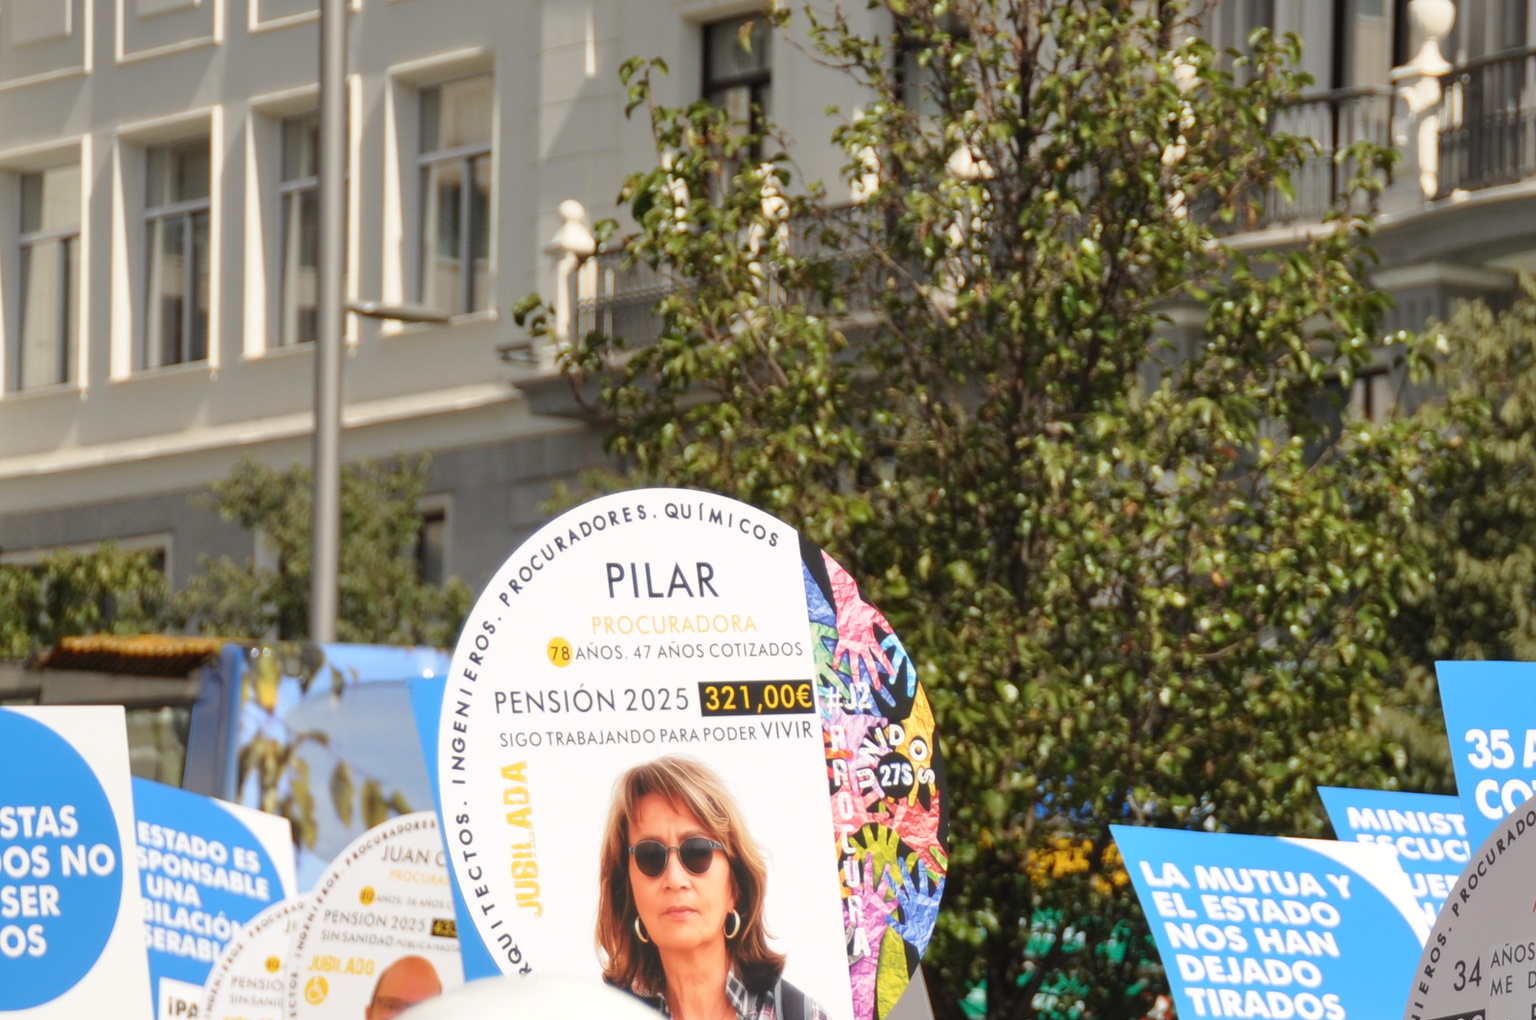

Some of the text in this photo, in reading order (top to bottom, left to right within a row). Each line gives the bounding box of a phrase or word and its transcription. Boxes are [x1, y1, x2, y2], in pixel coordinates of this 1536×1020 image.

[664, 502, 778, 547] QUÍMICOS
[605, 562, 719, 599] PILAR
[592, 614, 757, 635] PROCURADORA
[550, 641, 803, 661] 78 AÑOS. 47 AÑOS COTIZADOS
[495, 684, 812, 714] PENSIÓN 2025 321,00€
[500, 720, 813, 747] SIGO TRABAJANDO PARA PODER VIVIR
[1465, 729, 1515, 769] 35
[856, 724, 935, 788] UNIDOS
[879, 762, 914, 787] 27S
[1347, 806, 1467, 836] MINIST
[137, 820, 261, 874] ESTADO ES
[380, 844, 429, 865] JUAN
[500, 761, 543, 919] JUBILADA
[60, 843, 116, 877] NO
[146, 872, 202, 909] UNA
[1139, 860, 1351, 899] LA MUTUA Y
[0, 885, 61, 918] SER
[1151, 891, 1341, 928] EL ESTADO
[323, 908, 427, 933] PENSIÓN 2025
[340, 931, 394, 947] SANIDAD
[1163, 921, 1341, 958] NOS HAN
[1490, 943, 1535, 968] AÑOS
[307, 954, 374, 975] JUBILADO
[1175, 953, 1323, 989] DEJADO
[1453, 956, 1482, 992] 34
[1490, 975, 1513, 997] ME
